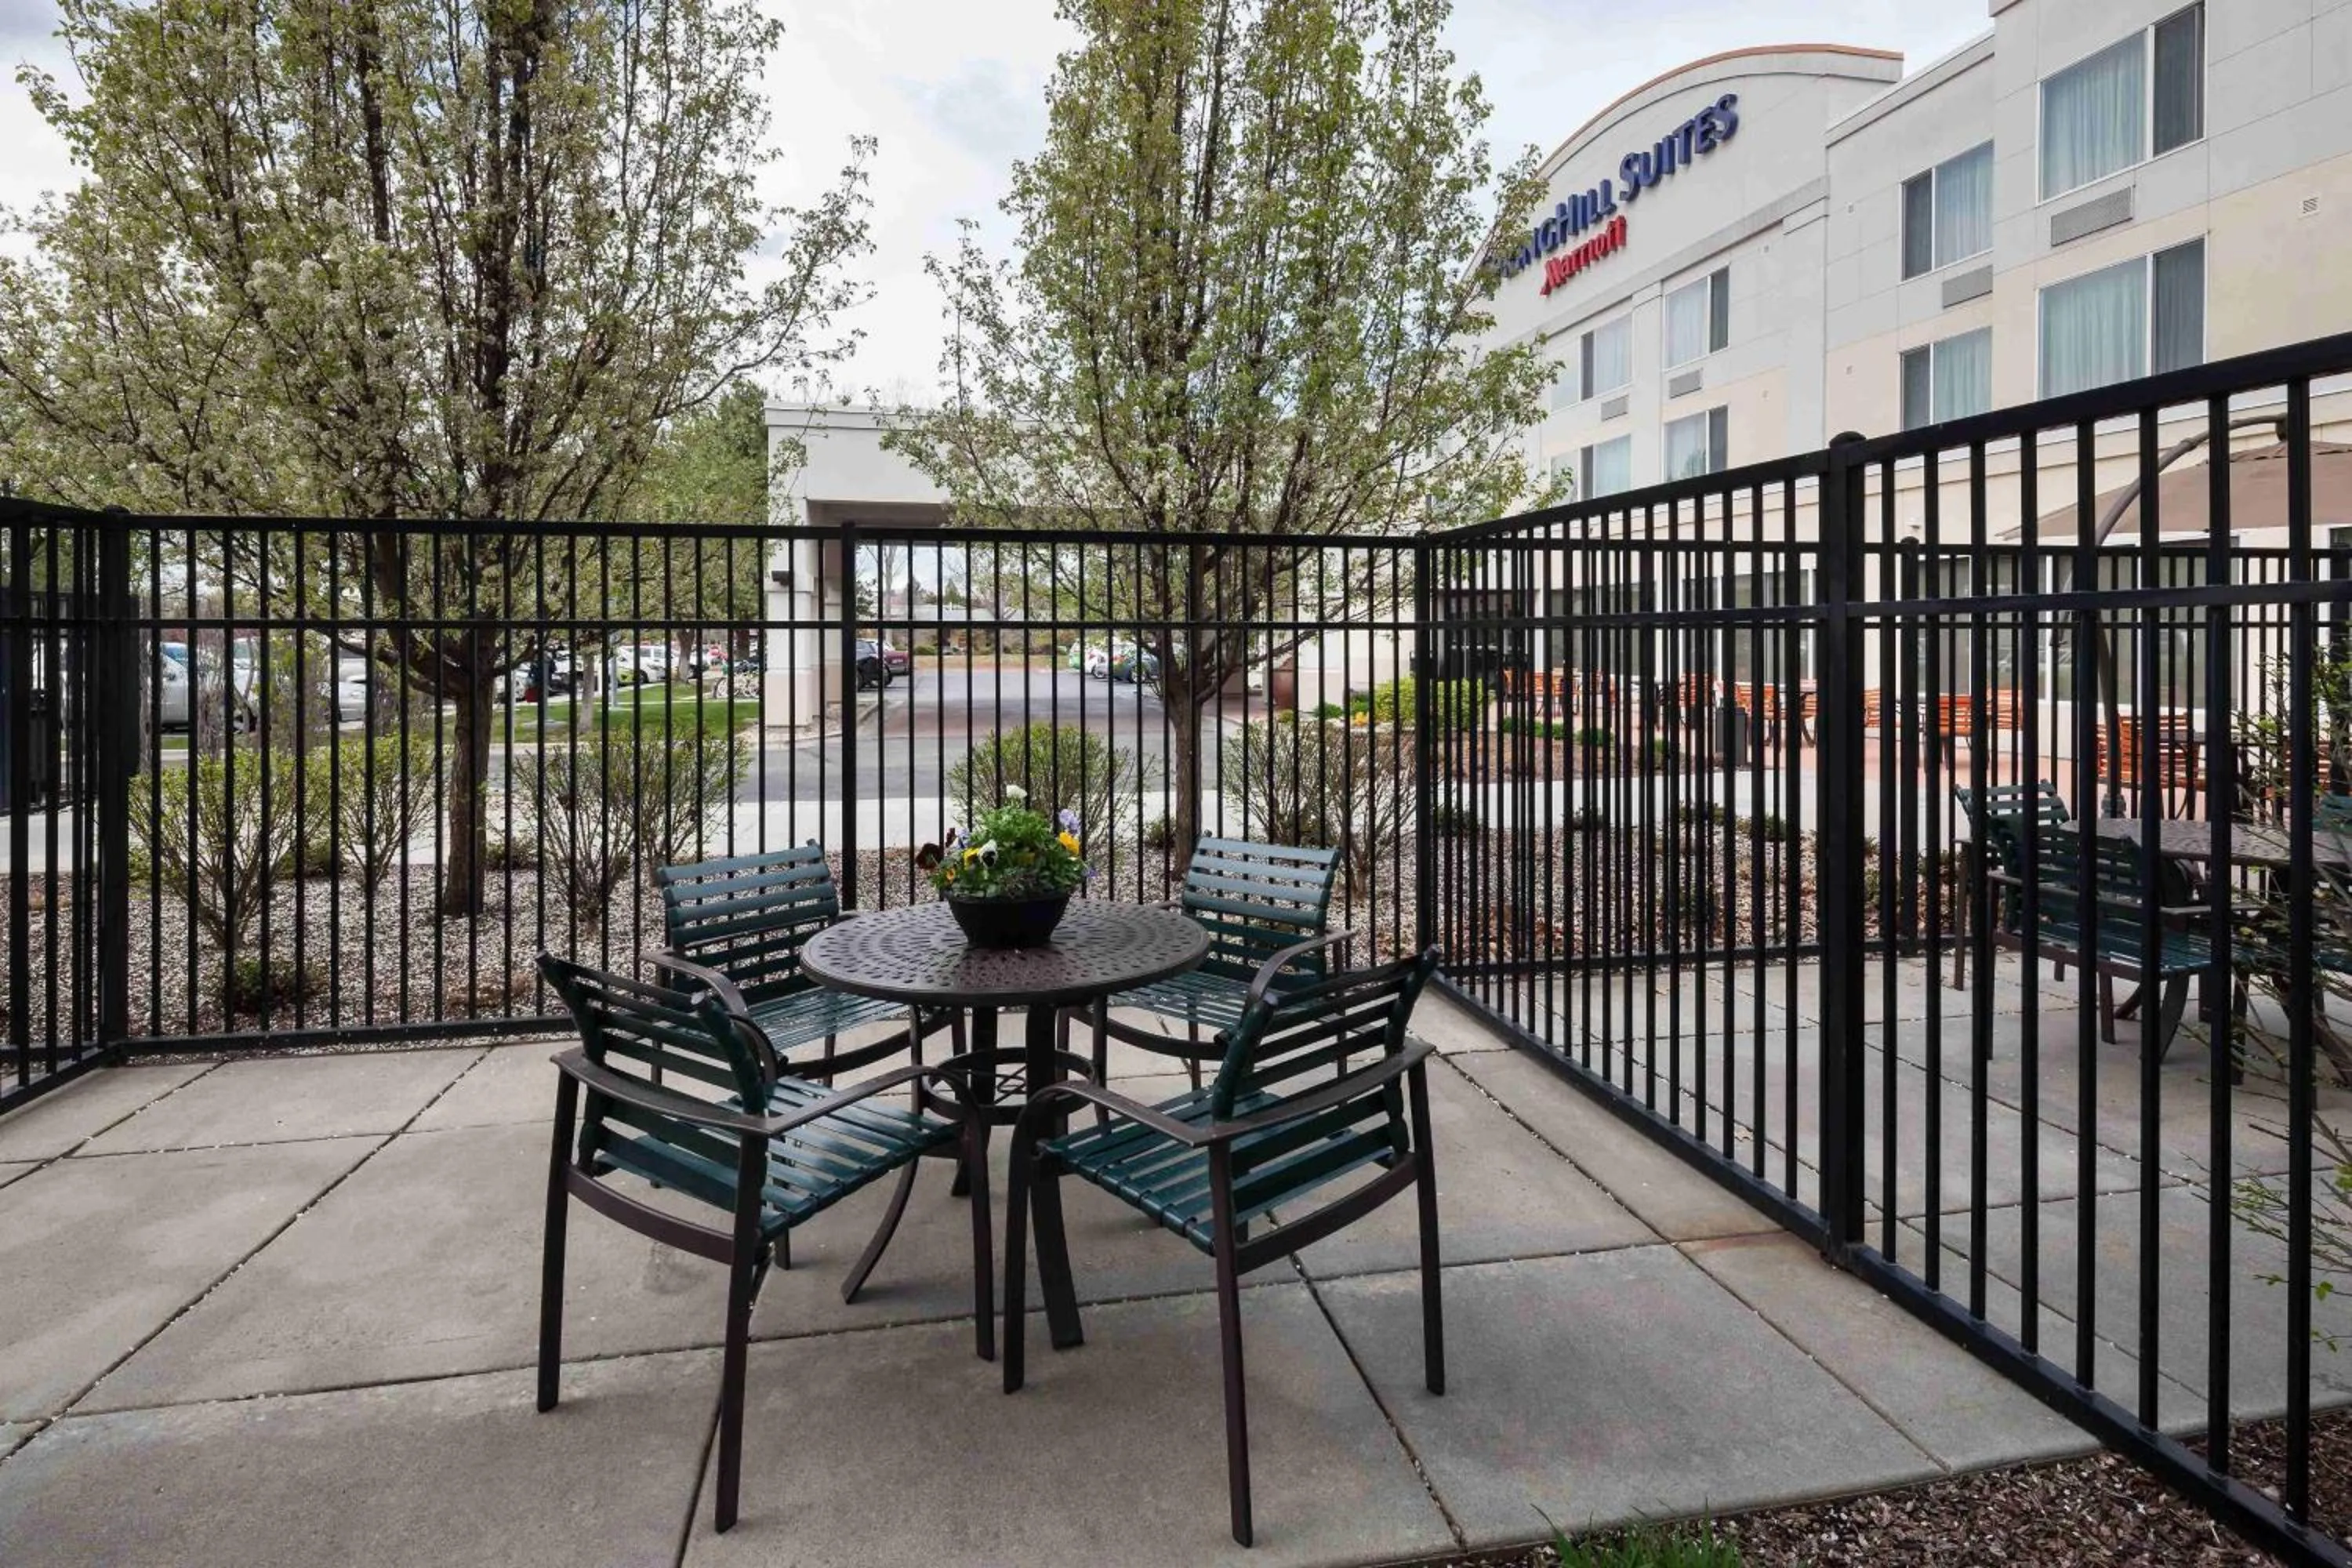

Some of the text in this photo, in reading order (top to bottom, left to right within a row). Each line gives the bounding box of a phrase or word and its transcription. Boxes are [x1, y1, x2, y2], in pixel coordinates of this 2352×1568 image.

[1500, 93, 1739, 278] NGHILL SUITES
[1539, 214, 1627, 296] Marriott
